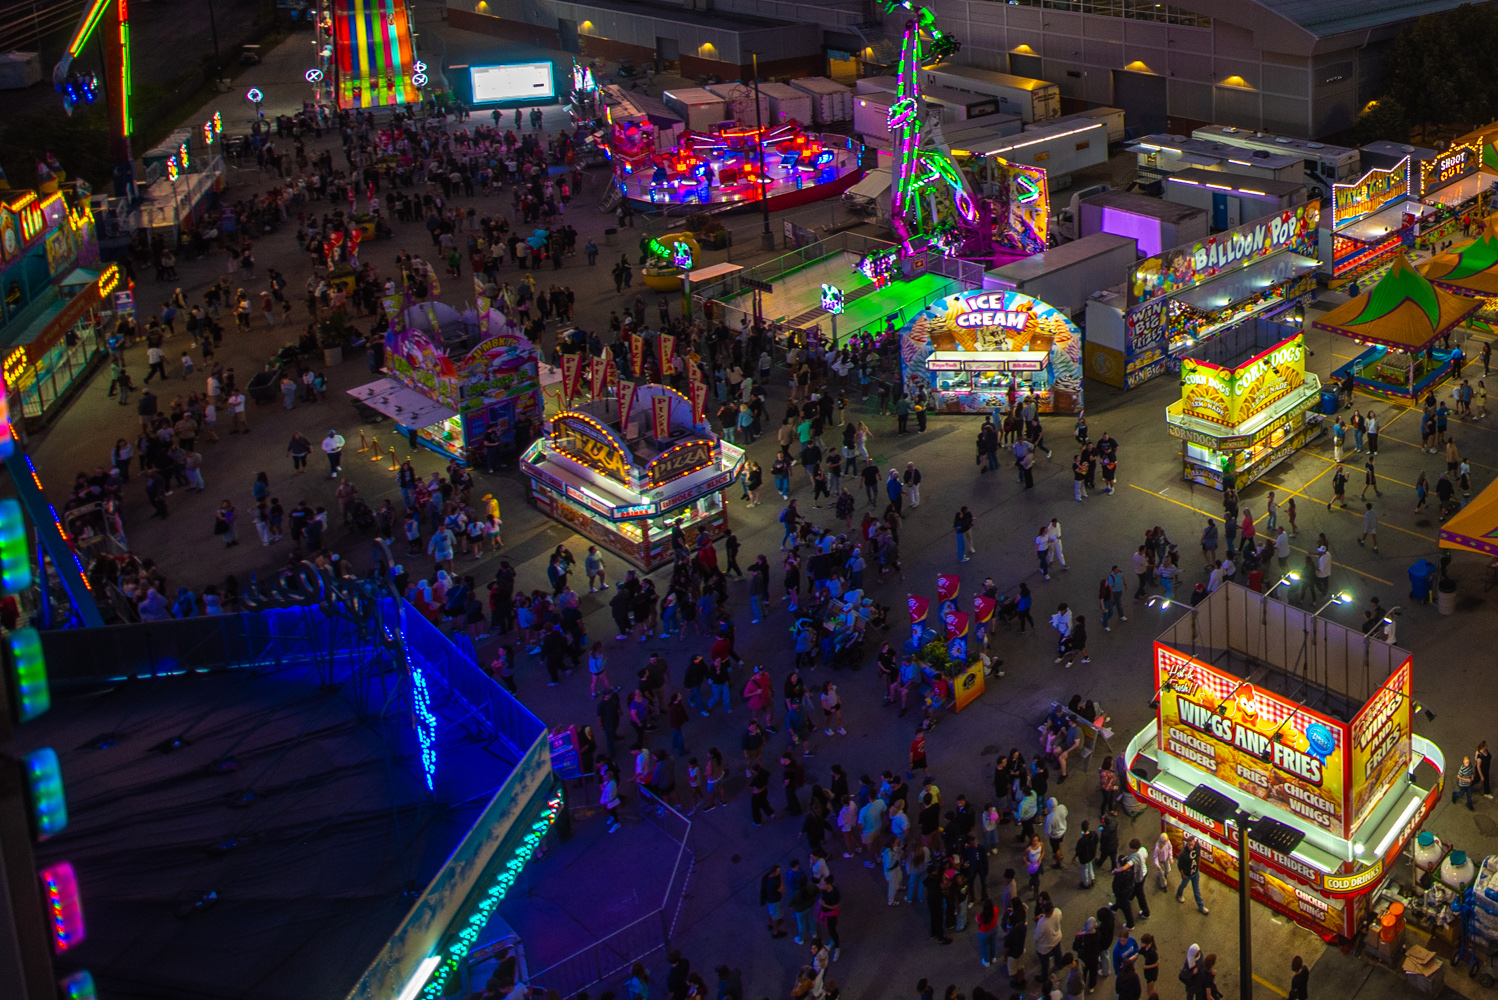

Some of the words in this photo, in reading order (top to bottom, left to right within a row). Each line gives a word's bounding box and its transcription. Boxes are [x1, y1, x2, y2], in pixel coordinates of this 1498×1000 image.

[1440, 152, 1465, 171] SHOOT
[1440, 163, 1464, 182] OUT!
[1194, 224, 1266, 271] BALLOON
[1271, 215, 1297, 245] POP
[968, 293, 1003, 311] ICE
[957, 312, 1027, 330] CREAM
[1185, 374, 1207, 385] CORN
[1208, 377, 1231, 396] DOGS
[1234, 357, 1268, 396] CORN
[1270, 347, 1302, 371] DOGS
[1169, 426, 1218, 448] CORNDOGS
[1254, 414, 1287, 442] JUMBO
[560, 422, 626, 478] PIZZA
[653, 448, 708, 481] PIZZA
[1190, 469, 1223, 483] LEMONAD
[661, 491, 693, 509] WHOLE
[706, 475, 730, 491] SLICE
[620, 509, 649, 518] DRINKS
[1360, 690, 1403, 750] WINGS
[1168, 727, 1216, 757] CHICKEN
[1178, 696, 1233, 743] WINGS
[1234, 724, 1272, 763] AND
[1273, 741, 1322, 784] FRIES
[1371, 721, 1392, 752] AND
[1168, 739, 1217, 771] TENDERS
[1366, 728, 1401, 779] FRIES
[1236, 764, 1269, 788] FRIES
[1147, 787, 1183, 817] CHICKEN
[1185, 804, 1216, 829] WINGS
[1283, 782, 1336, 815] CHICKEN
[1288, 798, 1331, 825] WINGS
[1398, 803, 1427, 846] FRIES
[1250, 869, 1265, 885] RIES
[1274, 852, 1316, 881] TENDERS
[1327, 878, 1350, 889] COLD
[1351, 867, 1380, 887] DRINKS
[1294, 887, 1328, 912] CHICKEN
[1299, 900, 1326, 921] WINGS
